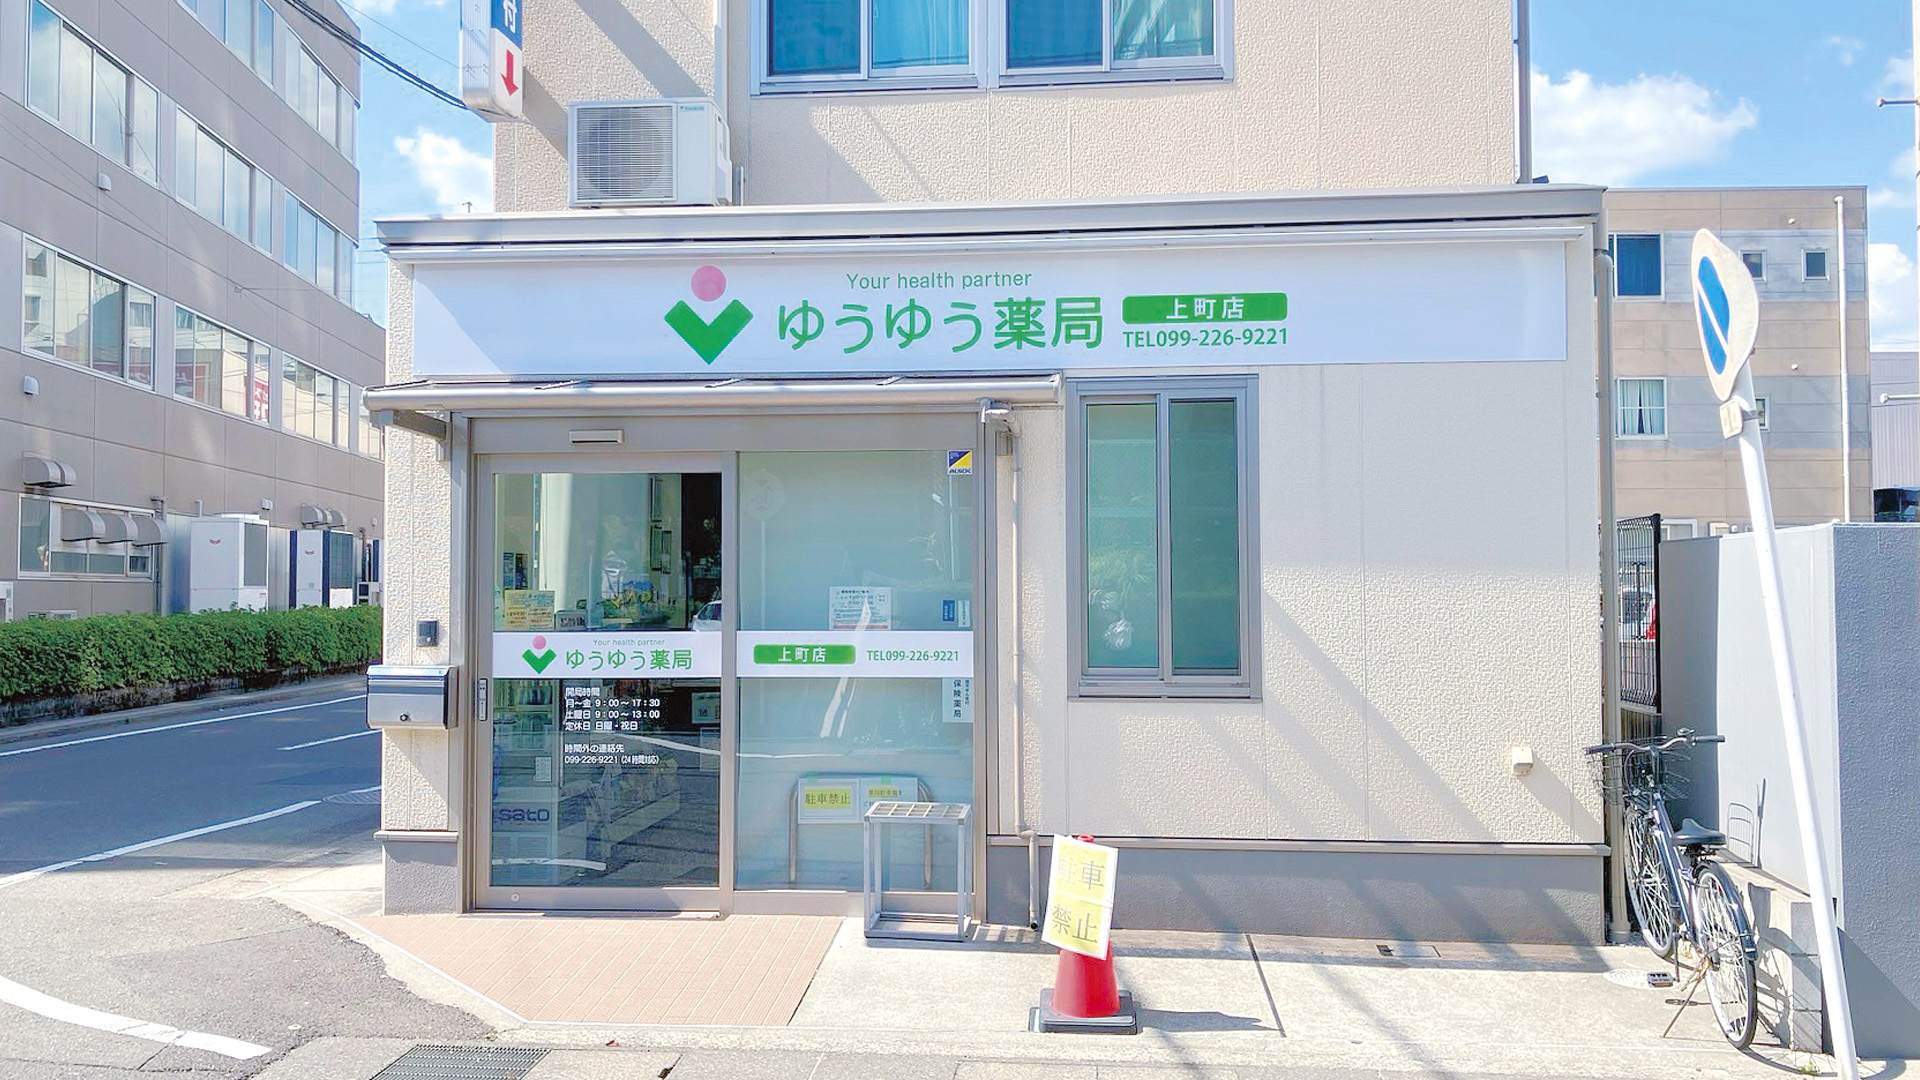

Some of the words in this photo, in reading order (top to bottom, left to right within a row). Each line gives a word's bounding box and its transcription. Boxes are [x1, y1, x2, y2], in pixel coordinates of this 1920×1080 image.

[847, 273, 890, 290] Your
[897, 272, 954, 289] health
[962, 272, 1032, 290] partner
[1166, 296, 1245, 320] 上町店
[778, 296, 1103, 354] ゆうゆう薬局
[1122, 328, 1287, 348] TEL099-226-9221
[612, 638, 636, 646] health
[637, 639, 665, 647] partner
[566, 649, 692, 671] ゆうゆう薬局
[778, 647, 827, 663] 上町店
[867, 650, 959, 661] TEL099-226-9221
[565, 687, 600, 697] 開局時間
[565, 709, 591, 719] 土曜日
[565, 720, 591, 731] 定休日
[564, 755, 618, 764] 099-226-9221
[805, 792, 850, 805] 駐車禁止
[1051, 904, 1098, 944] 禁止
